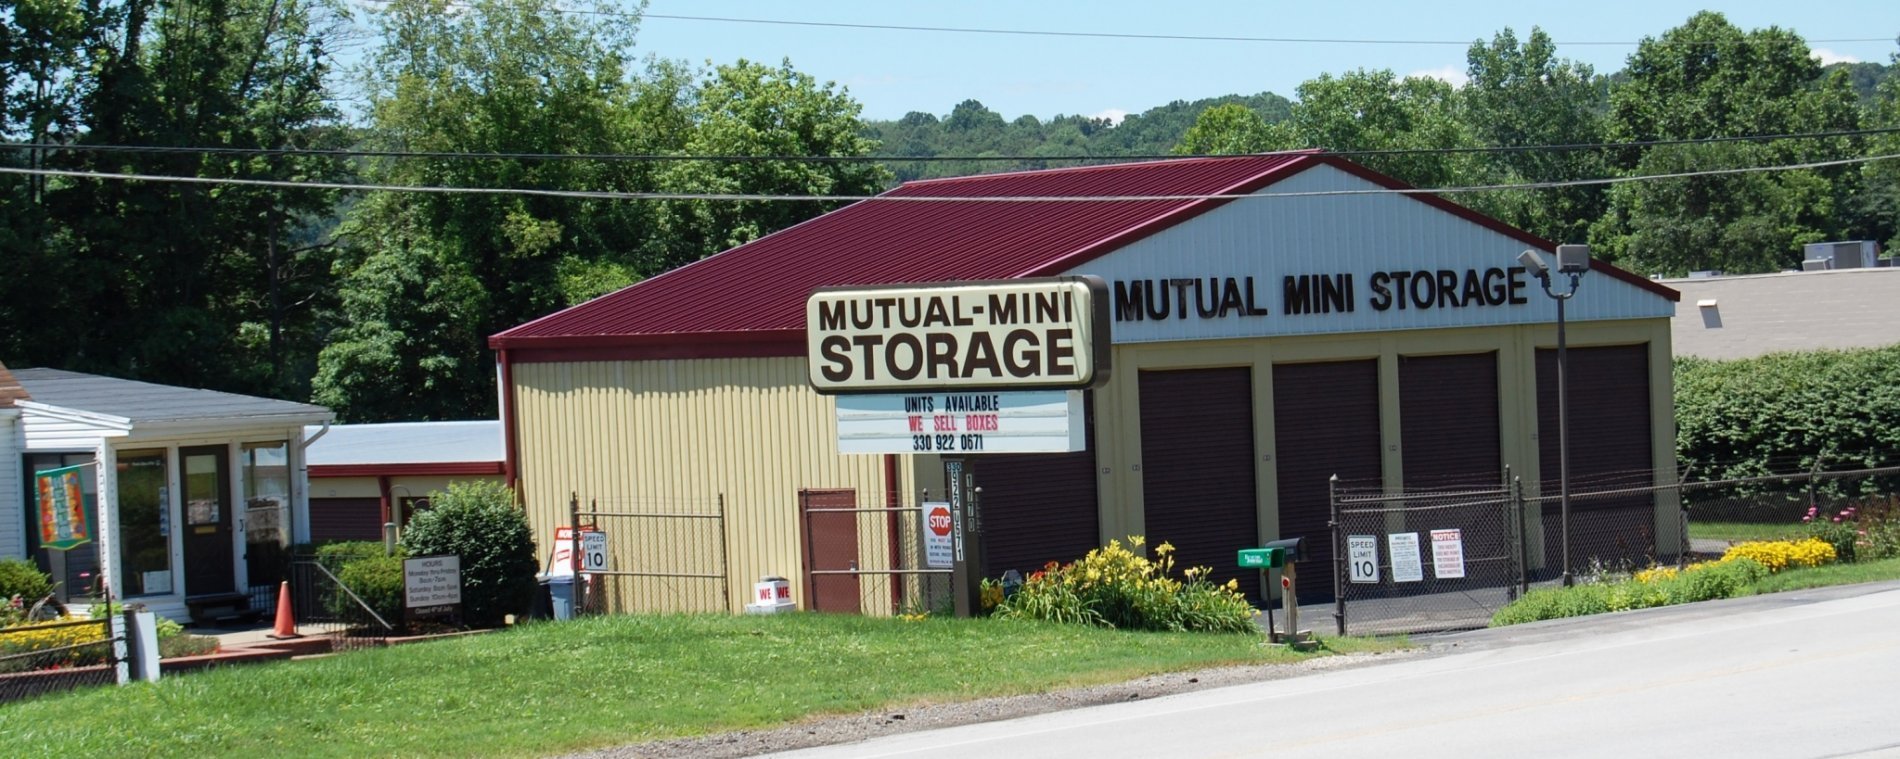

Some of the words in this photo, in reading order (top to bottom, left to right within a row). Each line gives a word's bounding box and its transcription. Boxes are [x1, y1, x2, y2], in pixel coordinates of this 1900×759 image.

[1114, 277, 1267, 322] MUTUAL
[1284, 273, 1354, 315] MINI
[1370, 266, 1528, 311] STORAGE
[819, 291, 1073, 331] MUTUAL-MINI
[820, 328, 1075, 382] STORAGE
[904, 396, 934, 413] UNITS
[945, 394, 999, 412] AVAILABLE
[908, 416, 923, 432] WE
[934, 415, 957, 431] SELL
[966, 414, 998, 431] BOXES
[912, 435, 932, 451] 330
[935, 434, 955, 450] 922
[960, 434, 984, 450] 0671
[930, 515, 951, 528] STOP
[1350, 541, 1374, 549] SPEED
[1433, 532, 1459, 541] NOTICE
[587, 552, 604, 567] 10
[1354, 560, 1374, 578] 10
[759, 587, 771, 601] WE
[776, 586, 790, 599] WE
